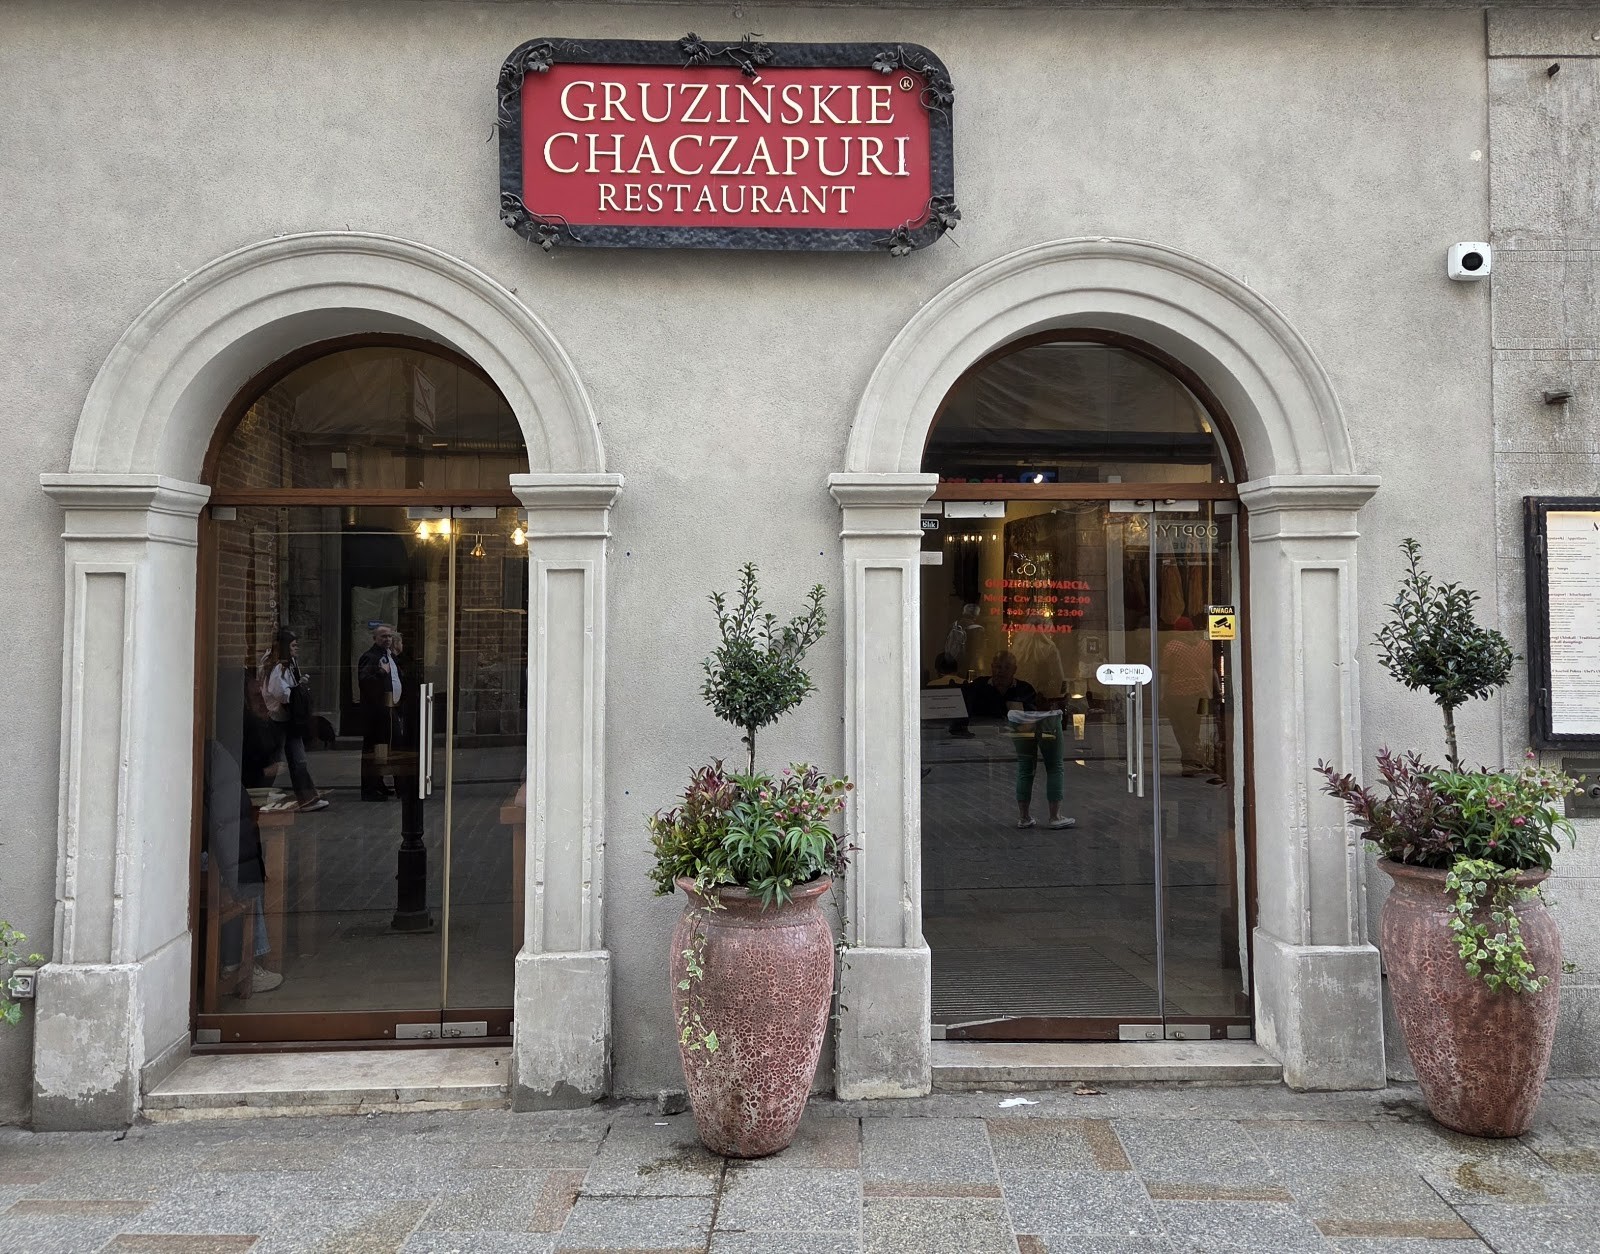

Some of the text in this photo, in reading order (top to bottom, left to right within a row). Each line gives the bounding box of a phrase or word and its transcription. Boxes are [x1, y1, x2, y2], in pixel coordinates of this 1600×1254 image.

[559, 76, 896, 125] GRUZIŃSKIE
[543, 132, 911, 178] CHACZAPURI
[597, 183, 856, 215] RESTAURANT
[1057, 608, 1084, 617] 23:00
[1064, 595, 1091, 604] 22:00
